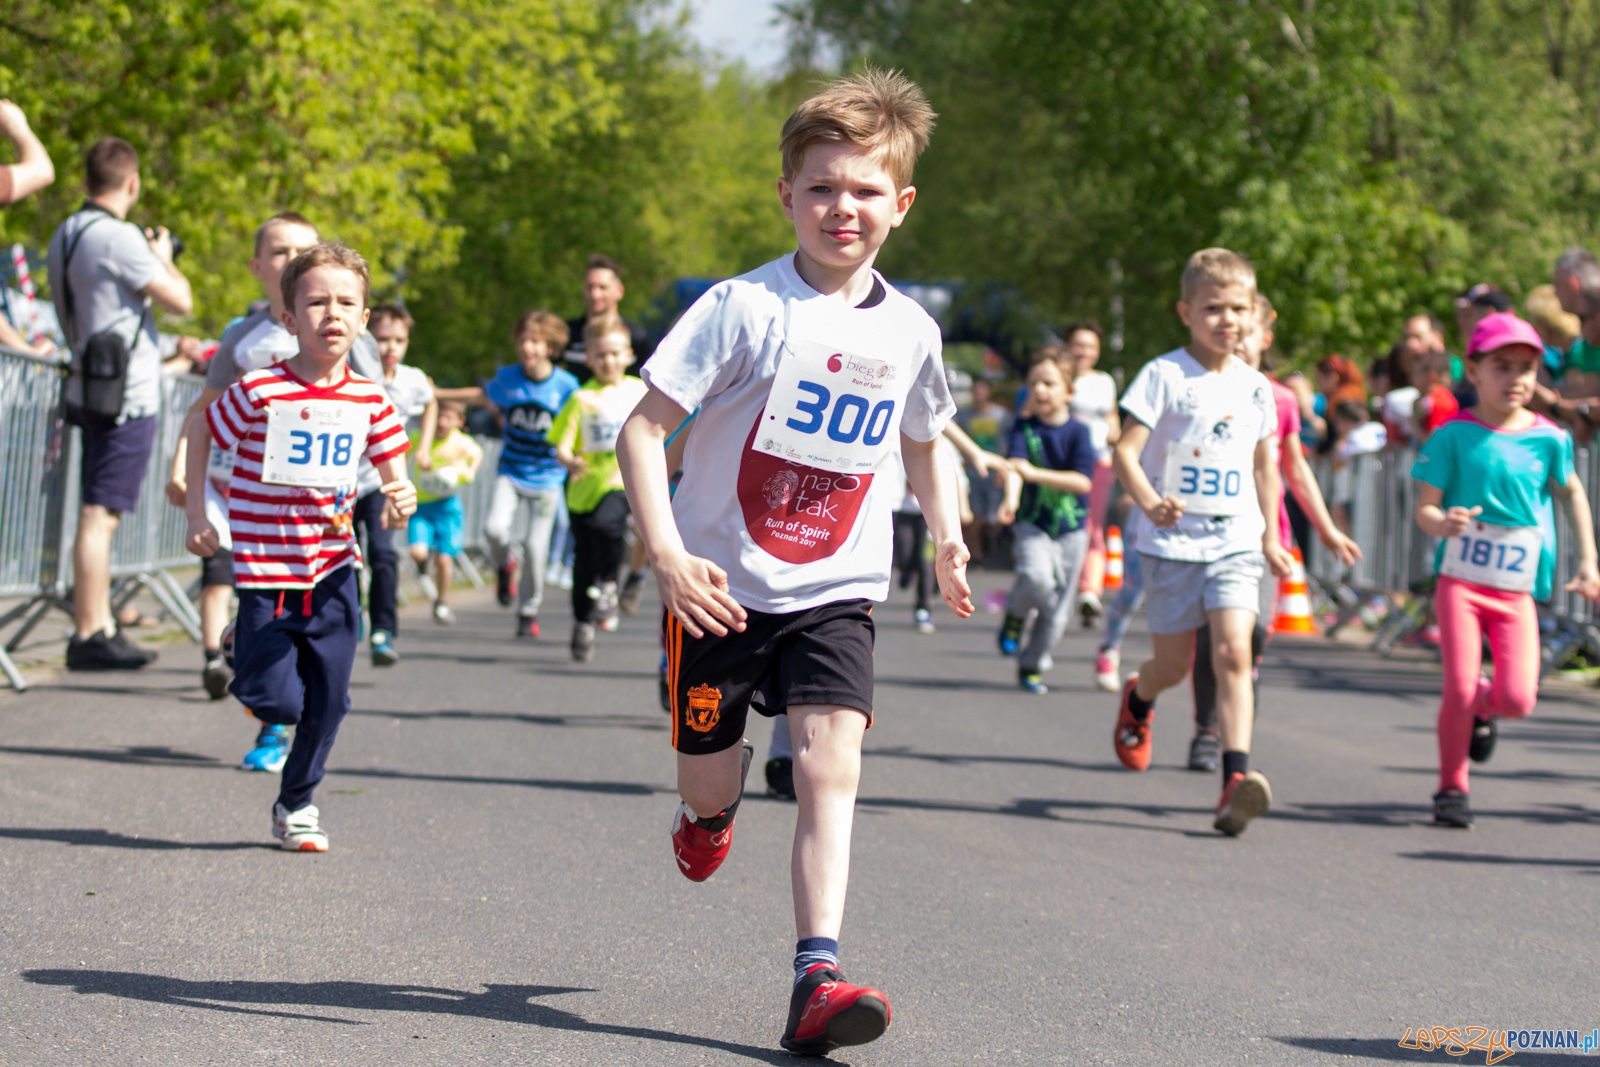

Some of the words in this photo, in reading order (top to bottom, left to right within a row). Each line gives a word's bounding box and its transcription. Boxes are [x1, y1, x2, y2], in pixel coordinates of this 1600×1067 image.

[847, 355, 875, 381] bieg
[852, 378, 863, 386] Run
[870, 382, 883, 390] Spirit
[510, 407, 553, 431] AIA
[786, 380, 895, 446] 300
[288, 430, 353, 466] 318
[1179, 466, 1240, 497] 330
[795, 490, 838, 522] tak
[765, 518, 784, 529] Run
[786, 521, 799, 532] of
[799, 524, 831, 541] Spirit
[771, 530, 798, 543] Poznań
[799, 537, 816, 548] 2017
[1460, 536, 1526, 573] 1812
